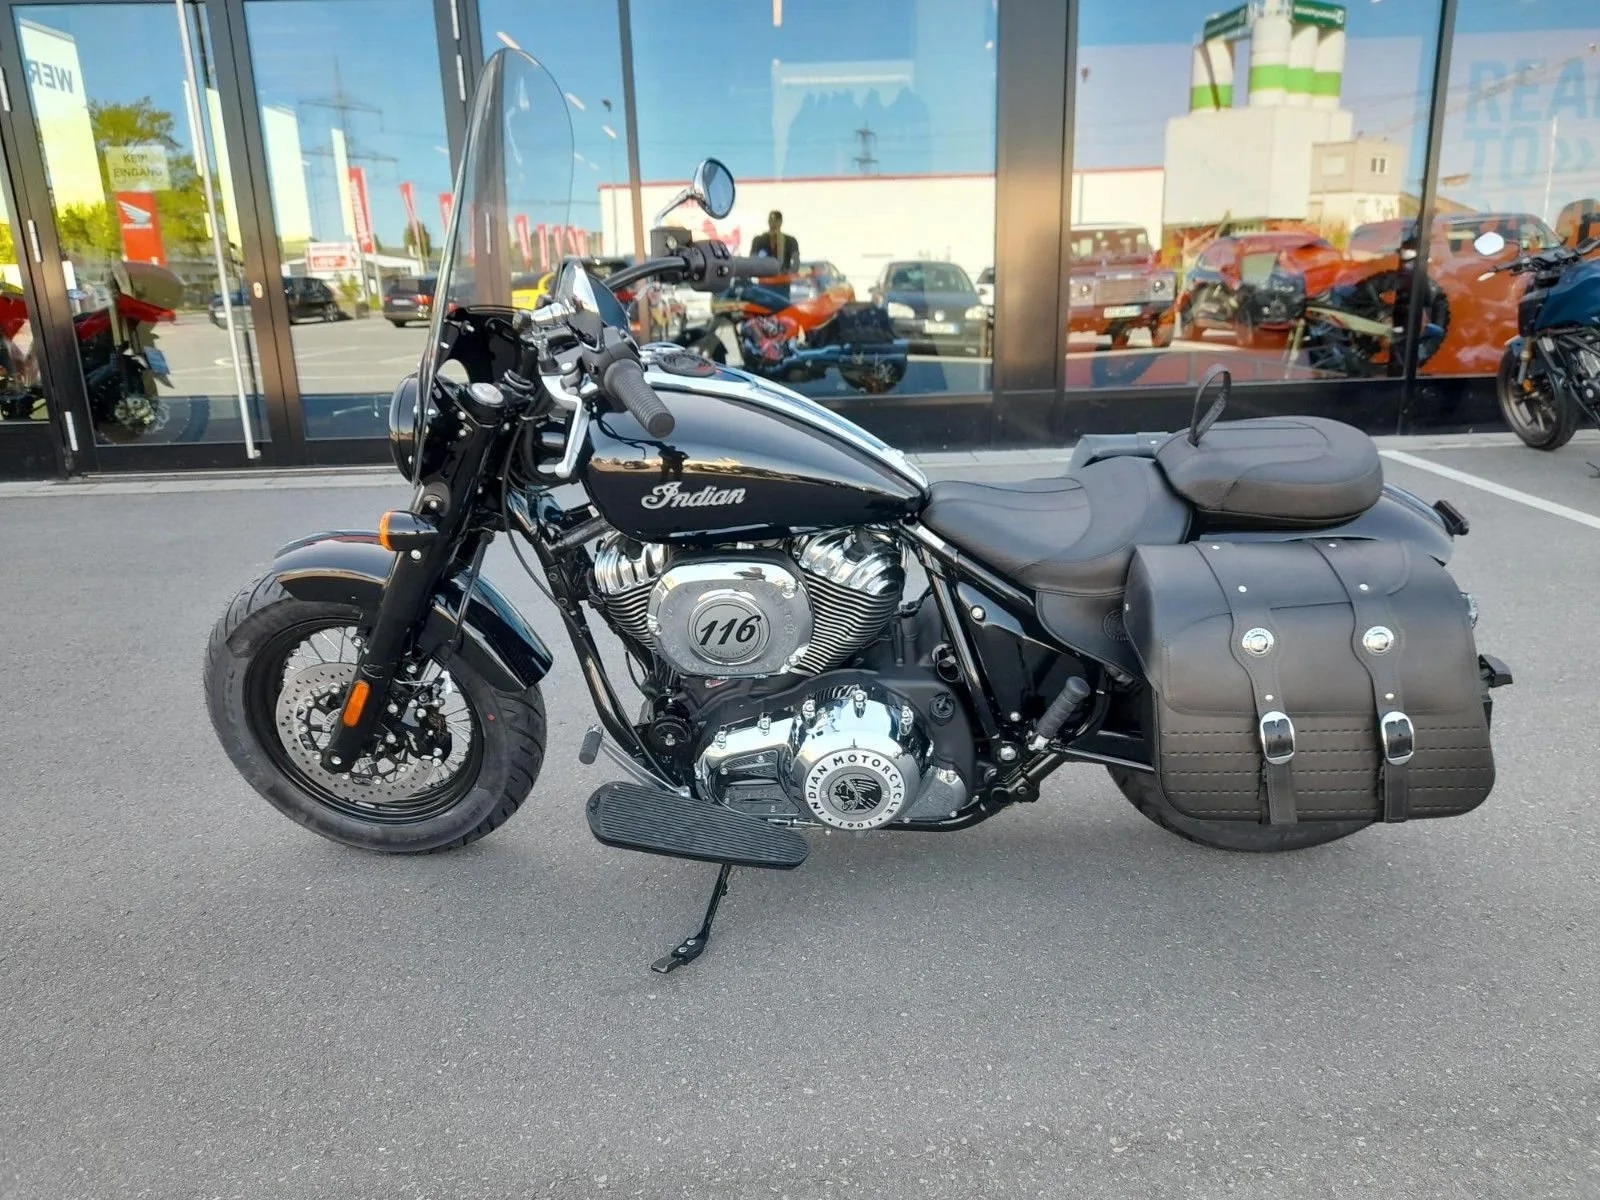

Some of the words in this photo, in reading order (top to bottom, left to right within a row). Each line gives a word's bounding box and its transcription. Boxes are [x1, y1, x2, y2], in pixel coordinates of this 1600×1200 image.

[1466, 58, 1600, 123] REA
[113, 168, 163, 178] EINGANG
[123, 153, 148, 164] KEIN
[641, 481, 746, 510] Indian
[699, 614, 762, 646] 116
[808, 765, 829, 815] INDIAN
[832, 754, 902, 814] MOTORCYCLE
